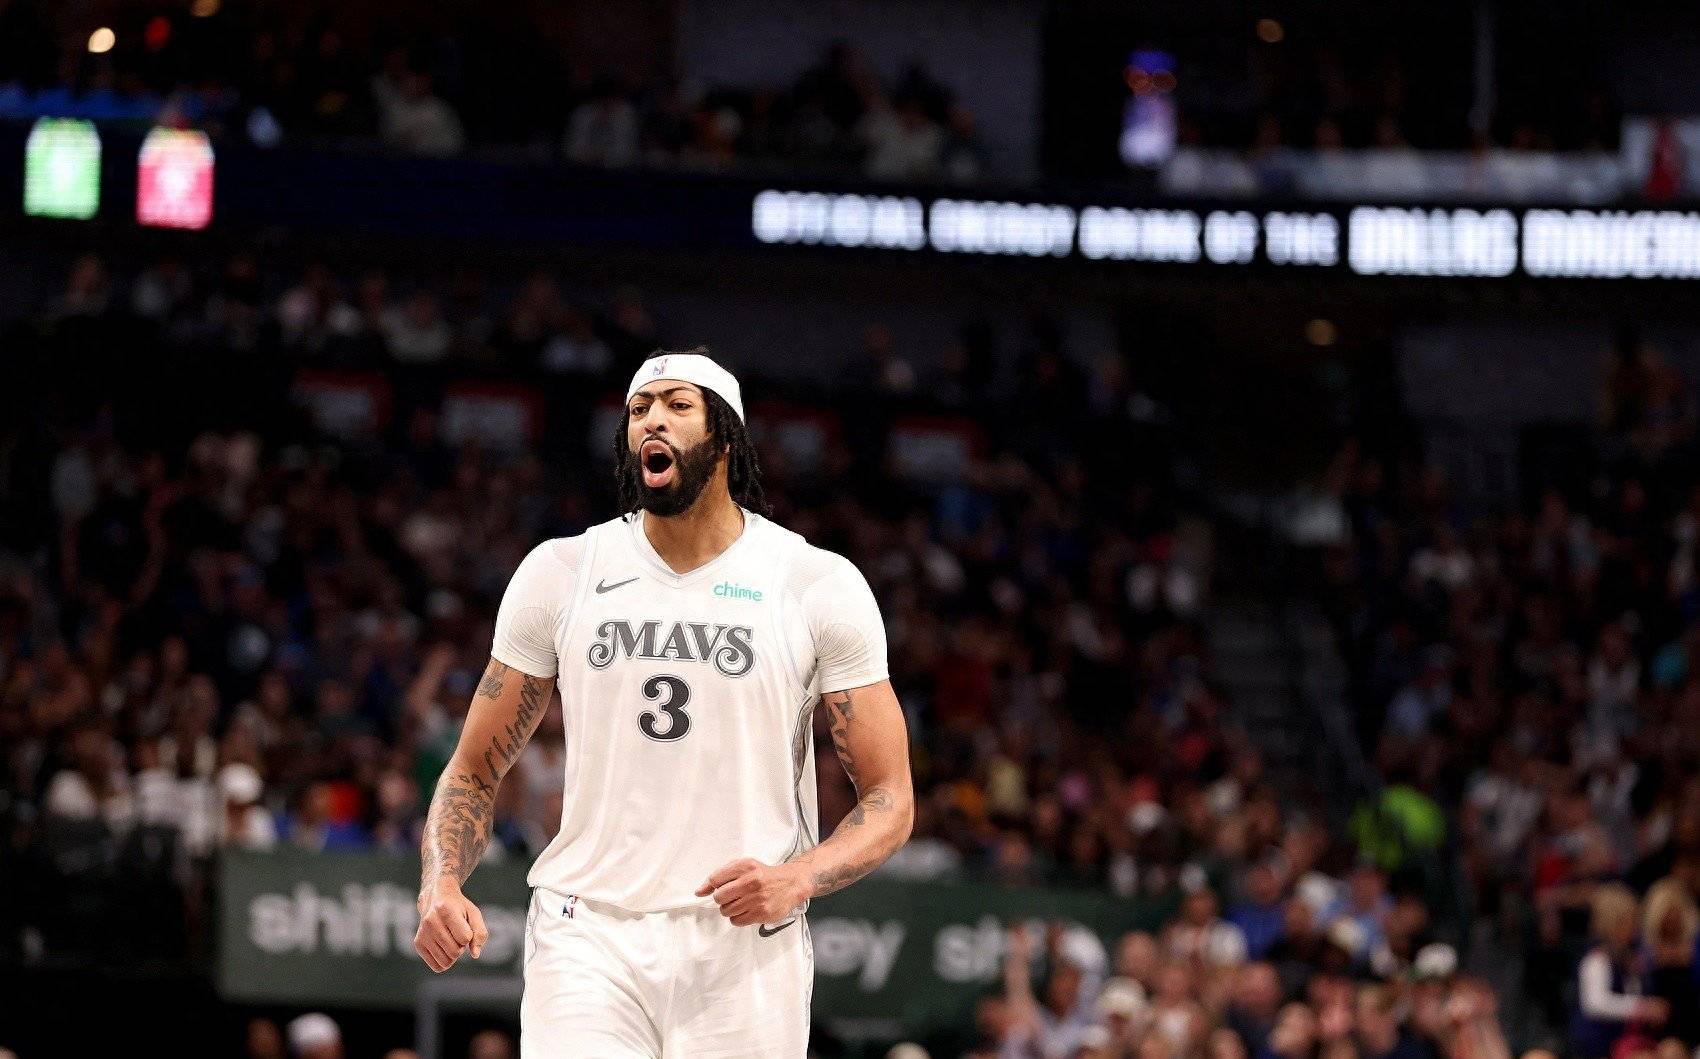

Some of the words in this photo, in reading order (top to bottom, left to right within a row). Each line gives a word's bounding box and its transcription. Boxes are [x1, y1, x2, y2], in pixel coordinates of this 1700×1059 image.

[1079, 207, 1200, 262] DRINK
[1205, 211, 1258, 264] OF
[1265, 213, 1338, 266] THE
[1348, 207, 1518, 277] DALLAS
[713, 581, 763, 602] chime
[587, 619, 757, 679] MAVS
[636, 673, 693, 743] 3
